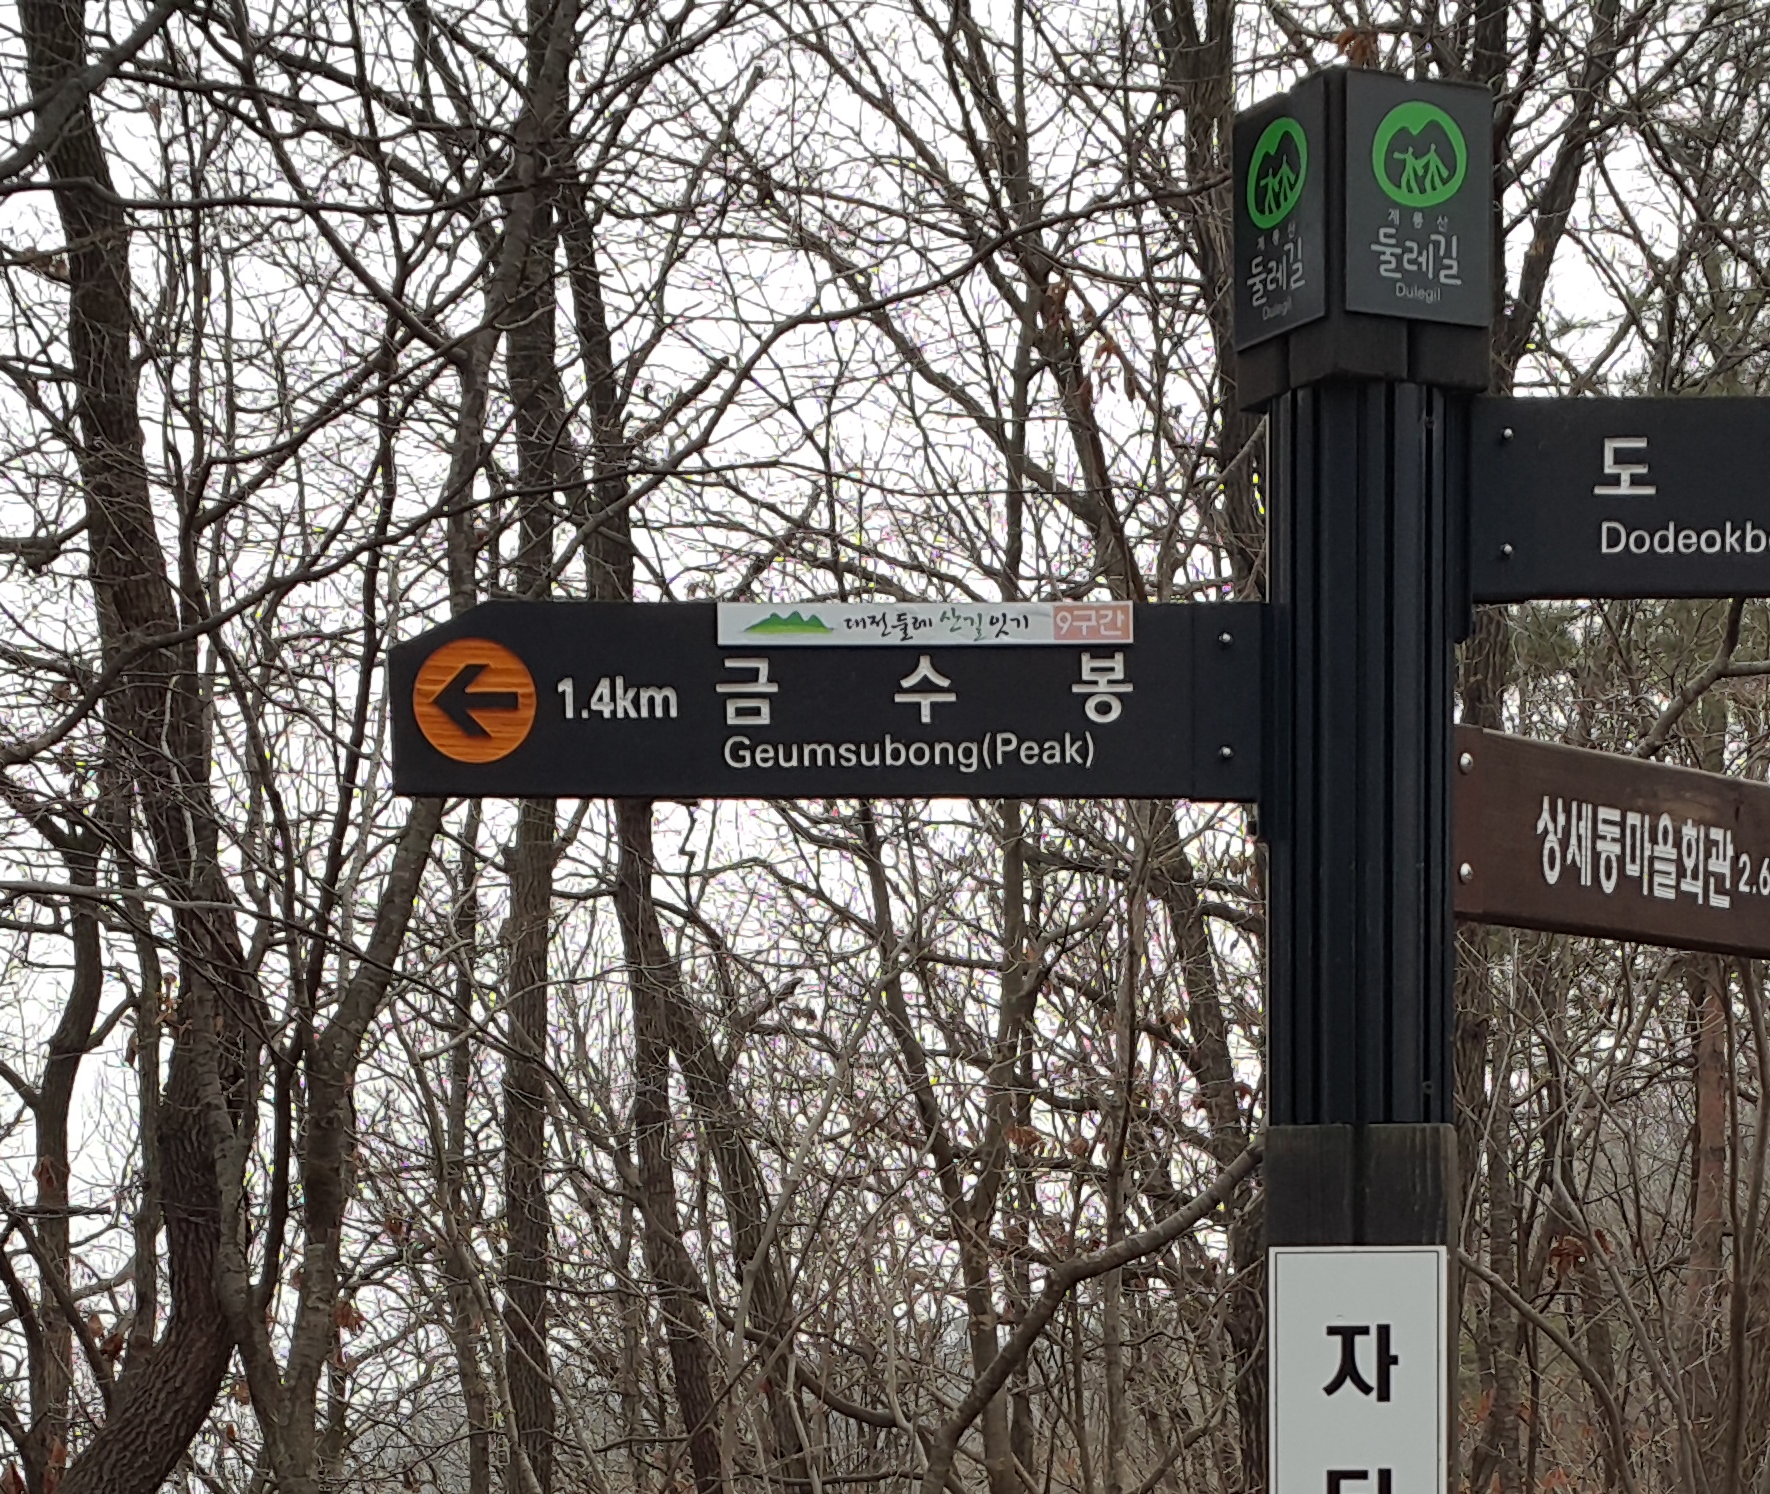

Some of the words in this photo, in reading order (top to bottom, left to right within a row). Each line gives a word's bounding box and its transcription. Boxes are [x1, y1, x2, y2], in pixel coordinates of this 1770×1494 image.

[1246, 235, 1306, 307] 둘레길
[1371, 227, 1462, 286] 둘레길
[1395, 281, 1441, 304] Dulegil
[1055, 609, 1124, 637] 9구간
[556, 675, 680, 720] 1.4km
[723, 731, 1096, 773] Geumsubong(Peak)
[1536, 795, 1734, 909] 상세동마을회관
